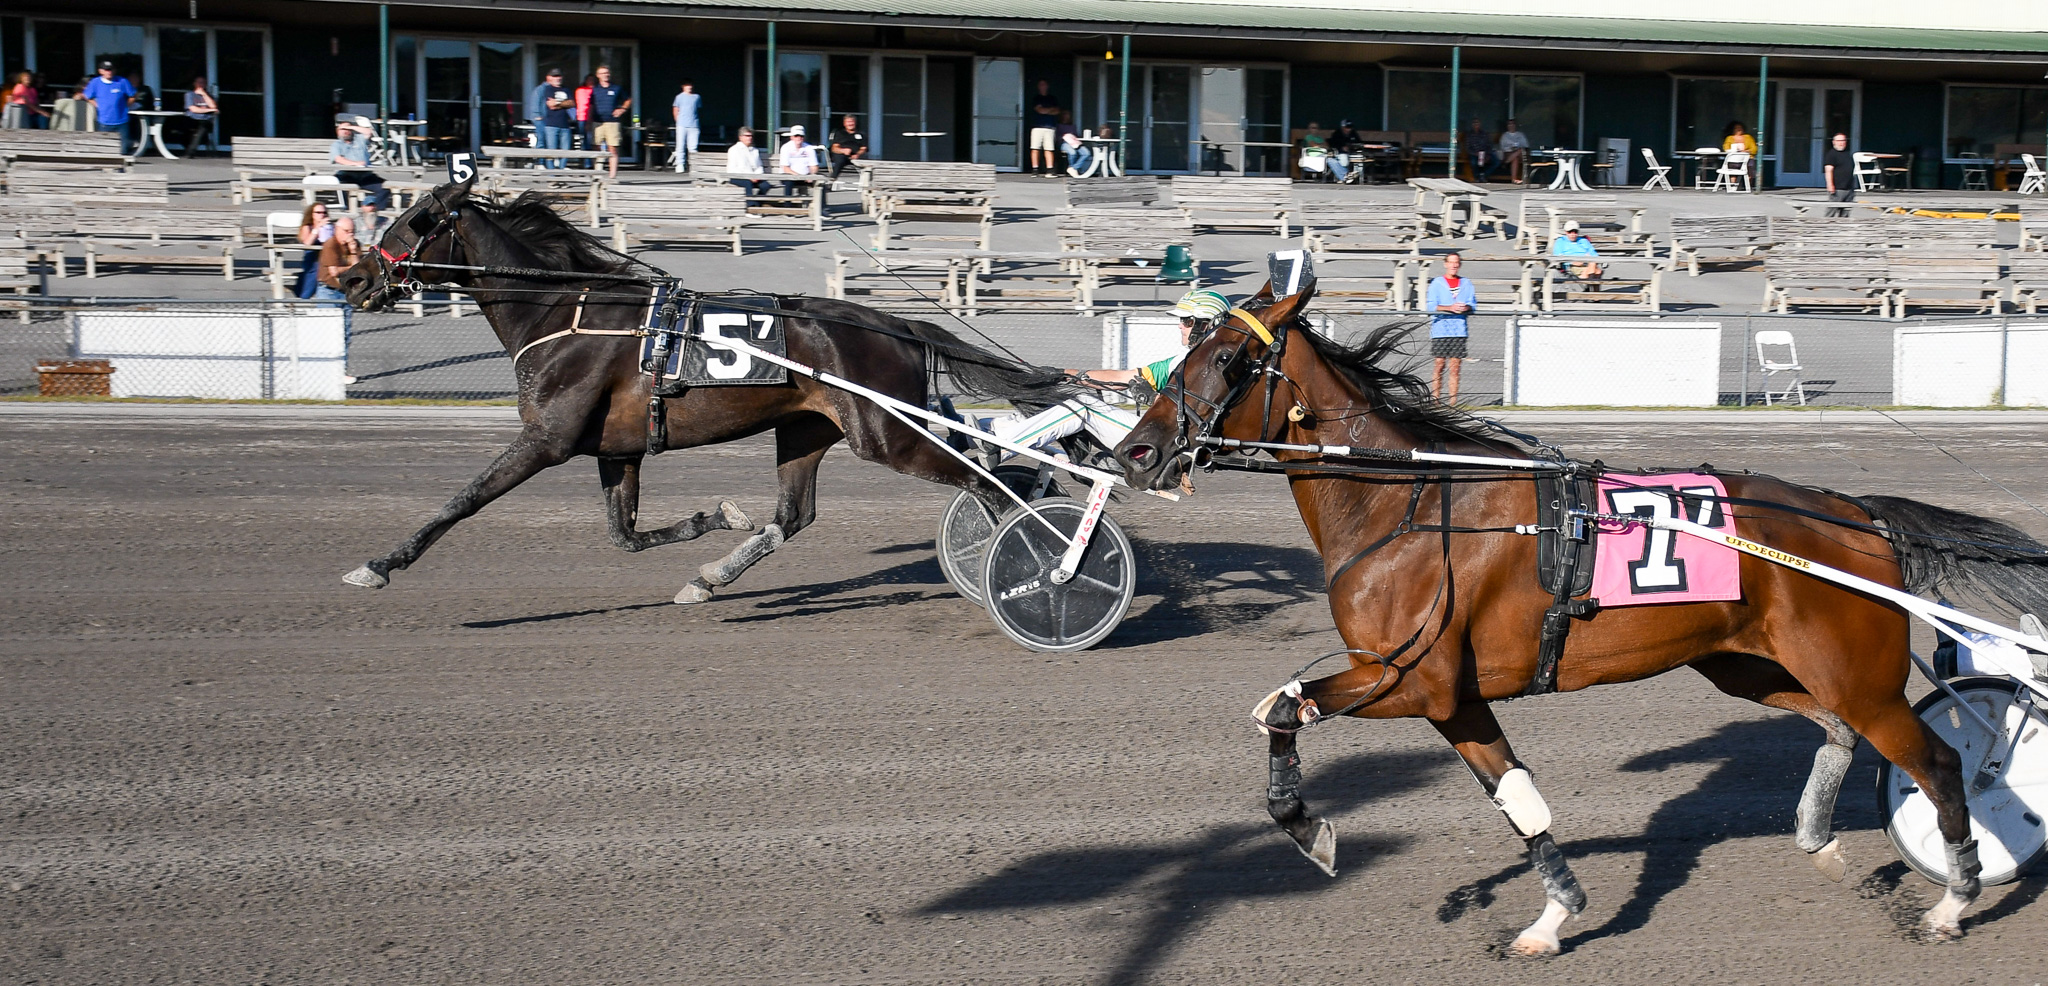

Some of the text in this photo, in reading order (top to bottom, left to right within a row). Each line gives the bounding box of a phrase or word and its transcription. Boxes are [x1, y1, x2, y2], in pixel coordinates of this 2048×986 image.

[452, 153, 473, 184] 5
[1275, 250, 1304, 296] 7
[703, 313, 751, 379] 5
[751, 314, 774, 339] 7
[1605, 487, 1686, 592] 7
